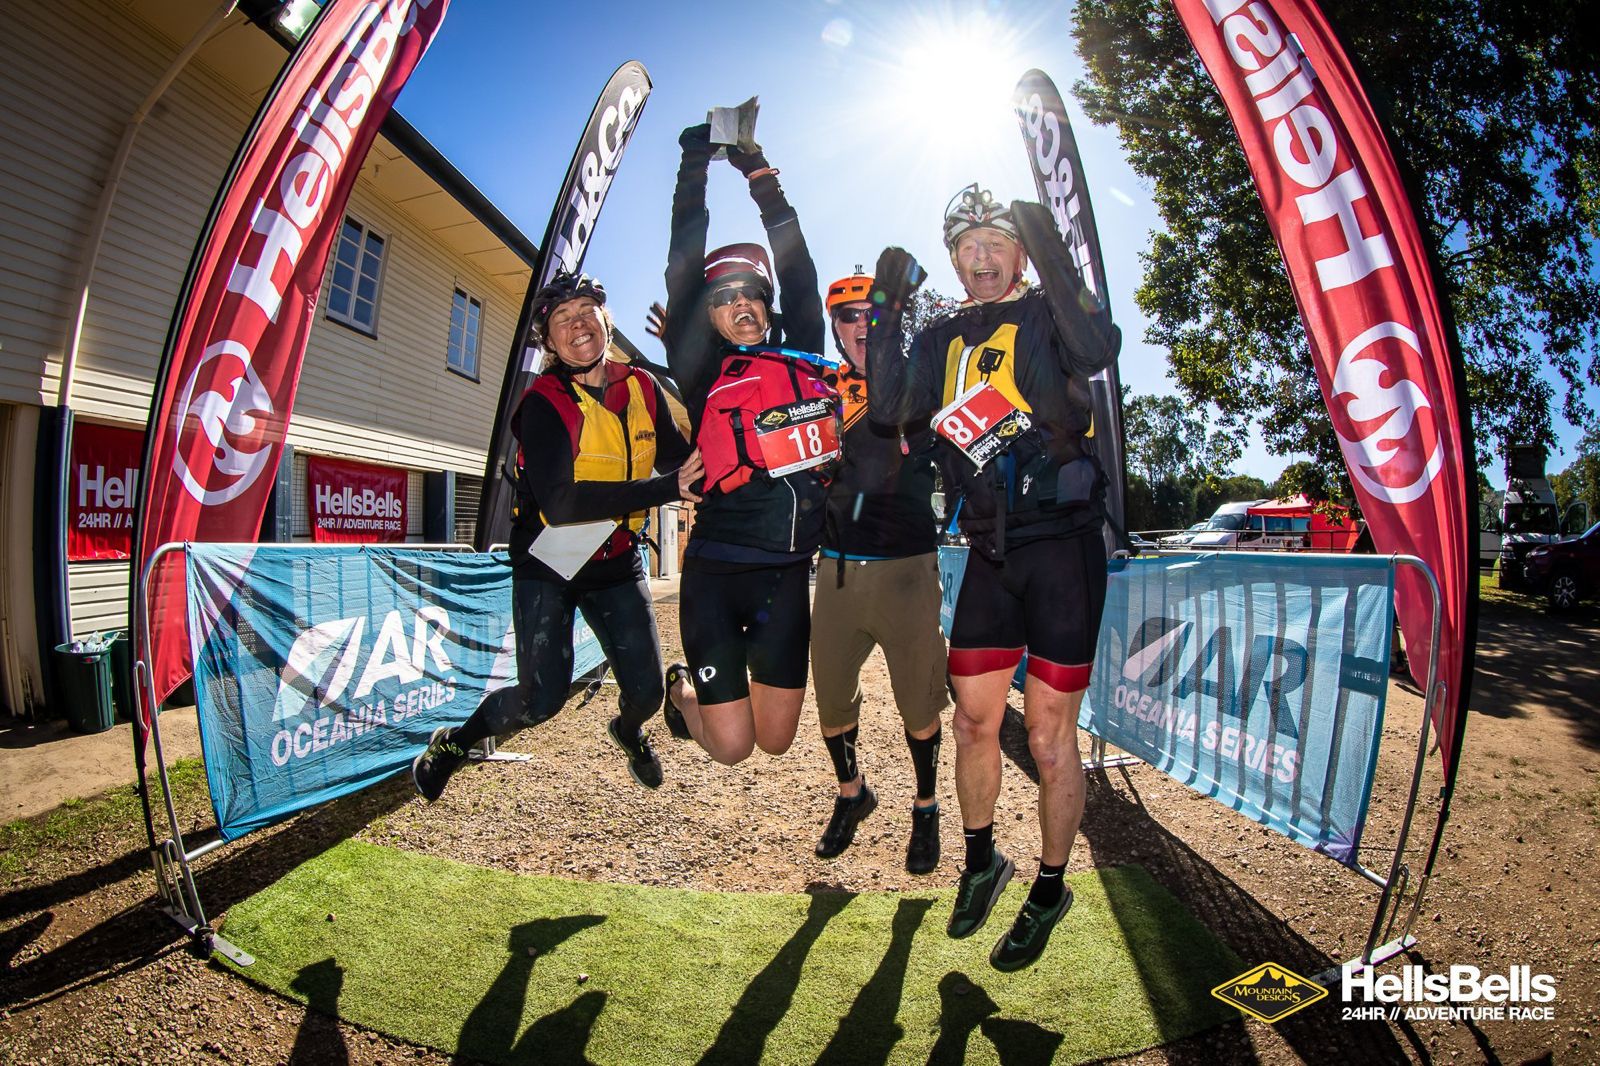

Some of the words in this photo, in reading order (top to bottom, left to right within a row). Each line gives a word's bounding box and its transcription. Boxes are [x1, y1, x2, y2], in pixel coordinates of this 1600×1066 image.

[227, 0, 432, 324] HellsBe
[788, 423, 822, 460] 18
[943, 406, 989, 444] 18
[79, 513, 111, 528] 24HR
[315, 484, 402, 518] HellsBells
[318, 518, 336, 529] 24HR
[343, 518, 382, 530] ADVENTURE
[384, 520, 402, 531] RACE
[353, 606, 453, 700] AR
[1172, 626, 1310, 739] AR
[271, 699, 387, 767] OCEANIA
[393, 676, 456, 723] SERIES
[1114, 685, 1197, 742] OCEANIA
[1202, 721, 1300, 783] SERIES
